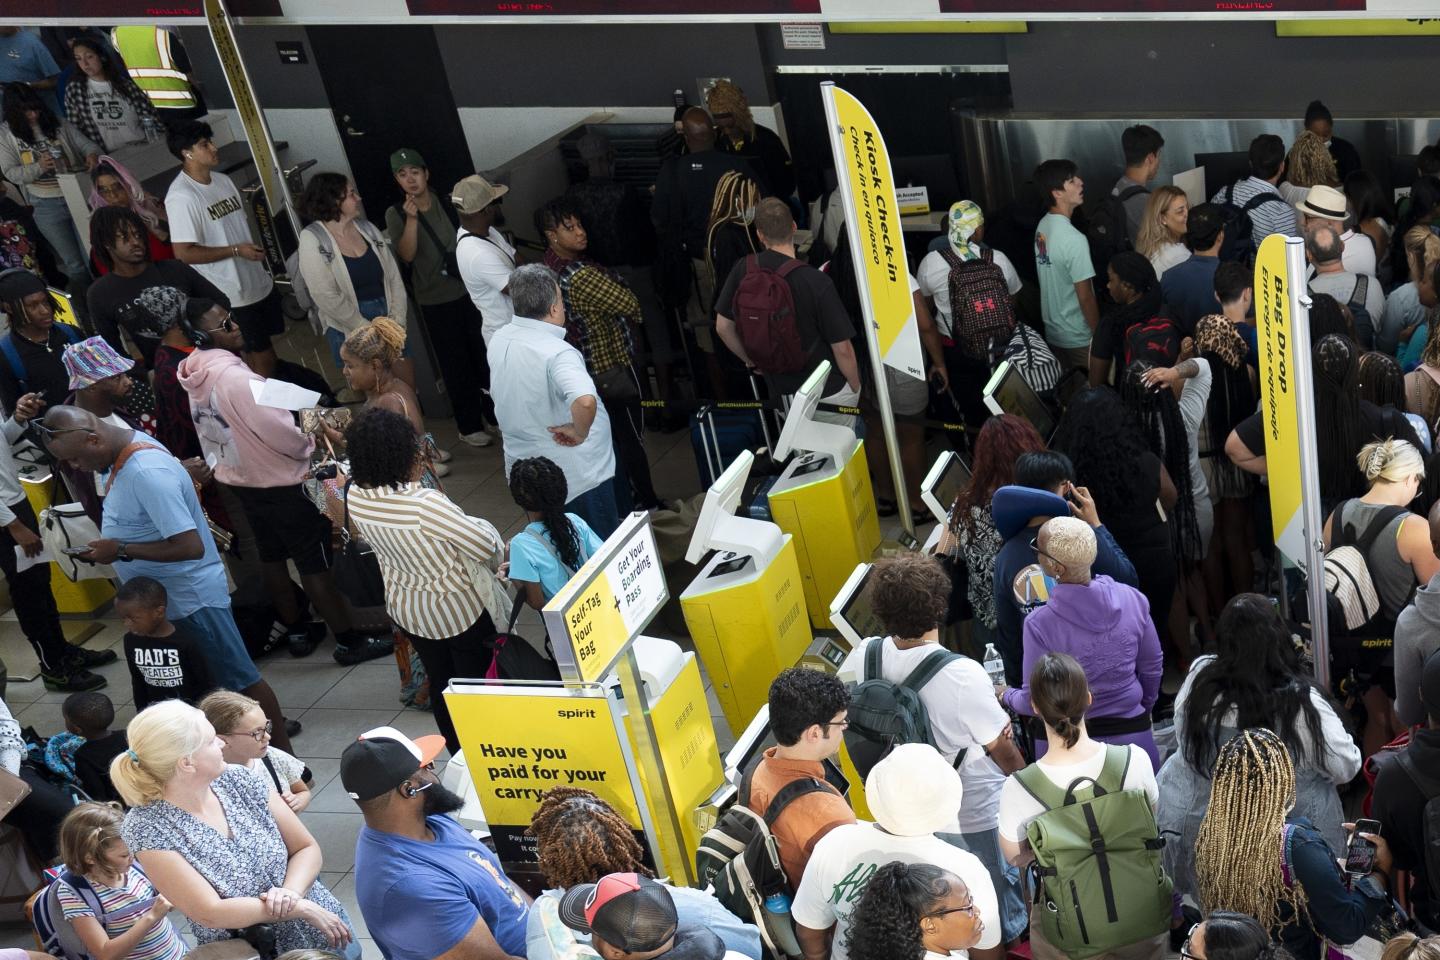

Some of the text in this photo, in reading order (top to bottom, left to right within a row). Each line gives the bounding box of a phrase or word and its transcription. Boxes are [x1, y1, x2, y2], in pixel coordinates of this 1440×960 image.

[850, 125, 865, 171] Check
[860, 190, 871, 208] en
[863, 129, 897, 283] Kiosk Check-in
[864, 210, 880, 266] quiosco
[1274, 274, 1288, 394] Bag Drop
[1261, 264, 1280, 441] Entrega de equipaje
[640, 400, 665, 408] spirit
[838, 406, 860, 415] spirit
[618, 538, 646, 575] Get Your
[621, 554, 652, 592] Boarding
[626, 584, 642, 608] Pass
[571, 592, 602, 628] Self-Tag
[574, 620, 592, 644] Your
[1362, 638, 1392, 648] spirit
[134, 648, 180, 666] DAD'S
[580, 640, 596, 662] Bag
[558, 708, 596, 719] spirit
[480, 744, 567, 762] Have you
[488, 764, 606, 784] paid for your
[508, 834, 522, 842] Pay
